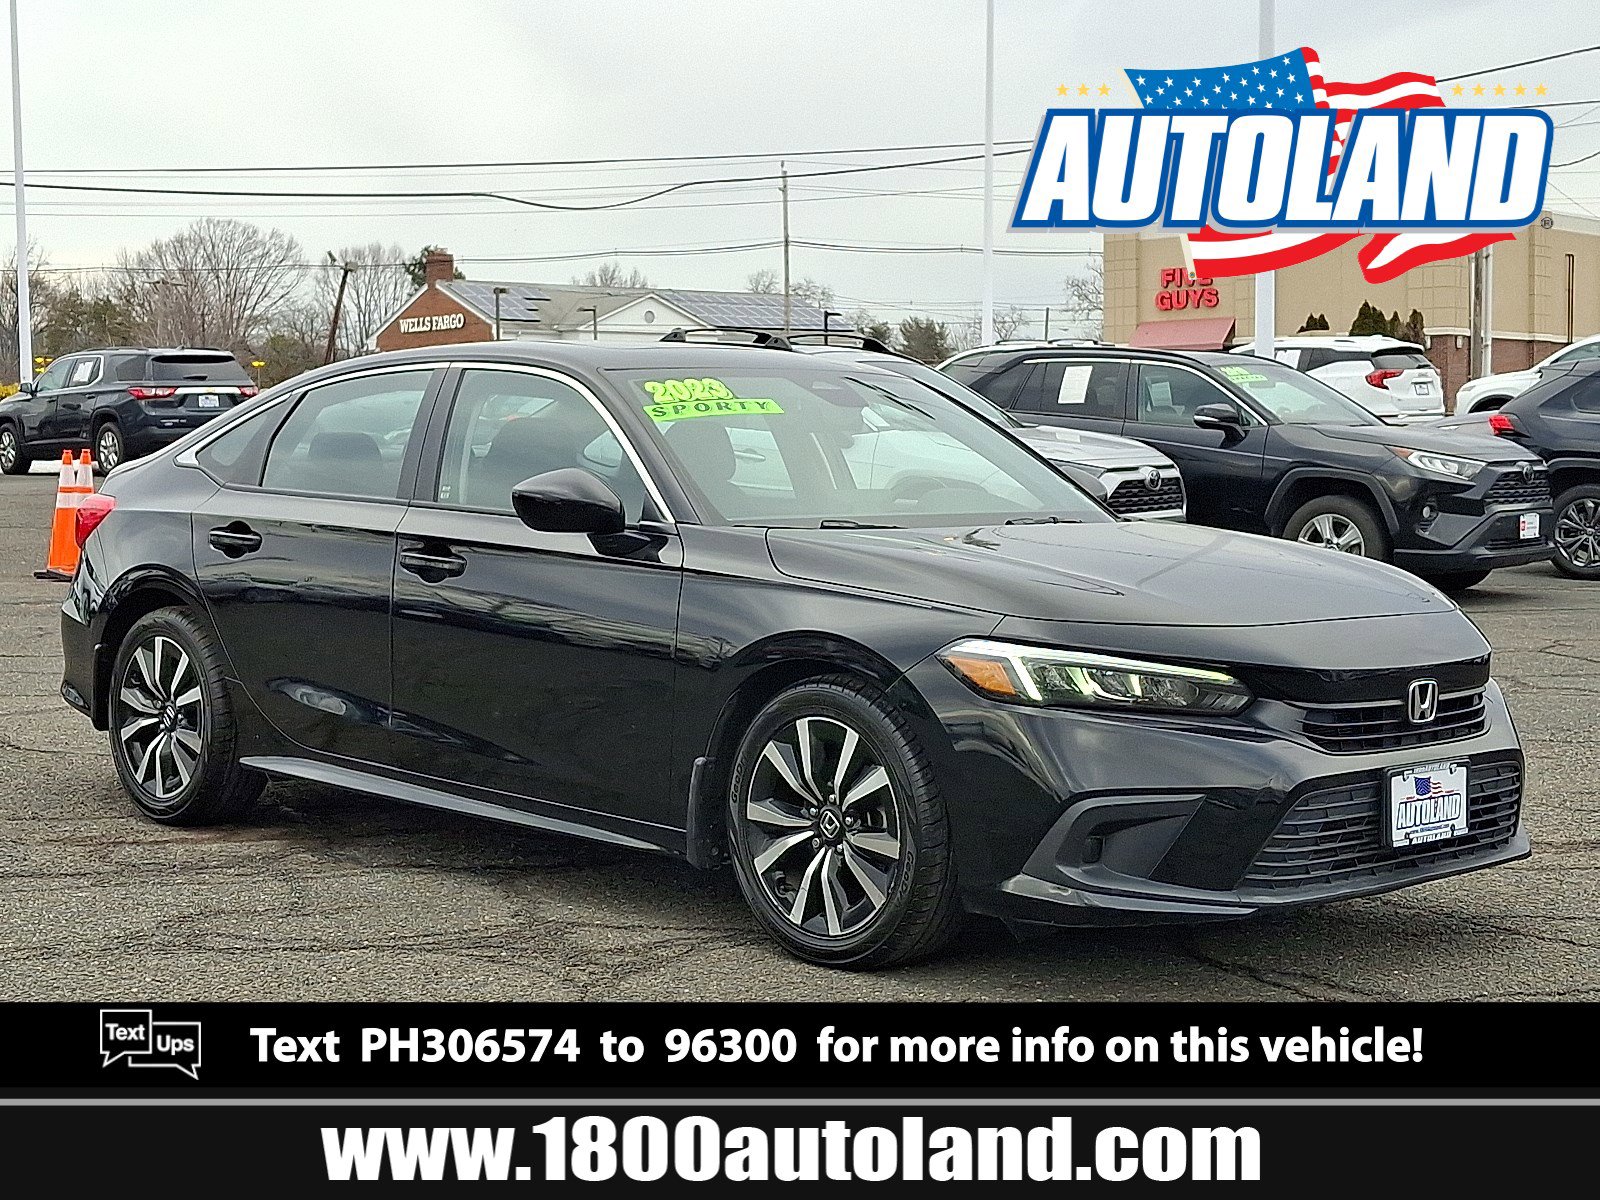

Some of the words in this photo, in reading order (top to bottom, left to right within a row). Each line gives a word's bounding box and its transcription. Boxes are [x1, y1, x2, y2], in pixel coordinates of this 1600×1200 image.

[1156, 288, 1219, 311] GUYS
[399, 316, 431, 333] WELLS
[432, 313, 466, 331] FARGO
[645, 377, 734, 405] 2023
[651, 400, 769, 418] SPORTY
[1397, 793, 1461, 830] AUTOLAND
[1411, 831, 1452, 845] AUTOLAND
